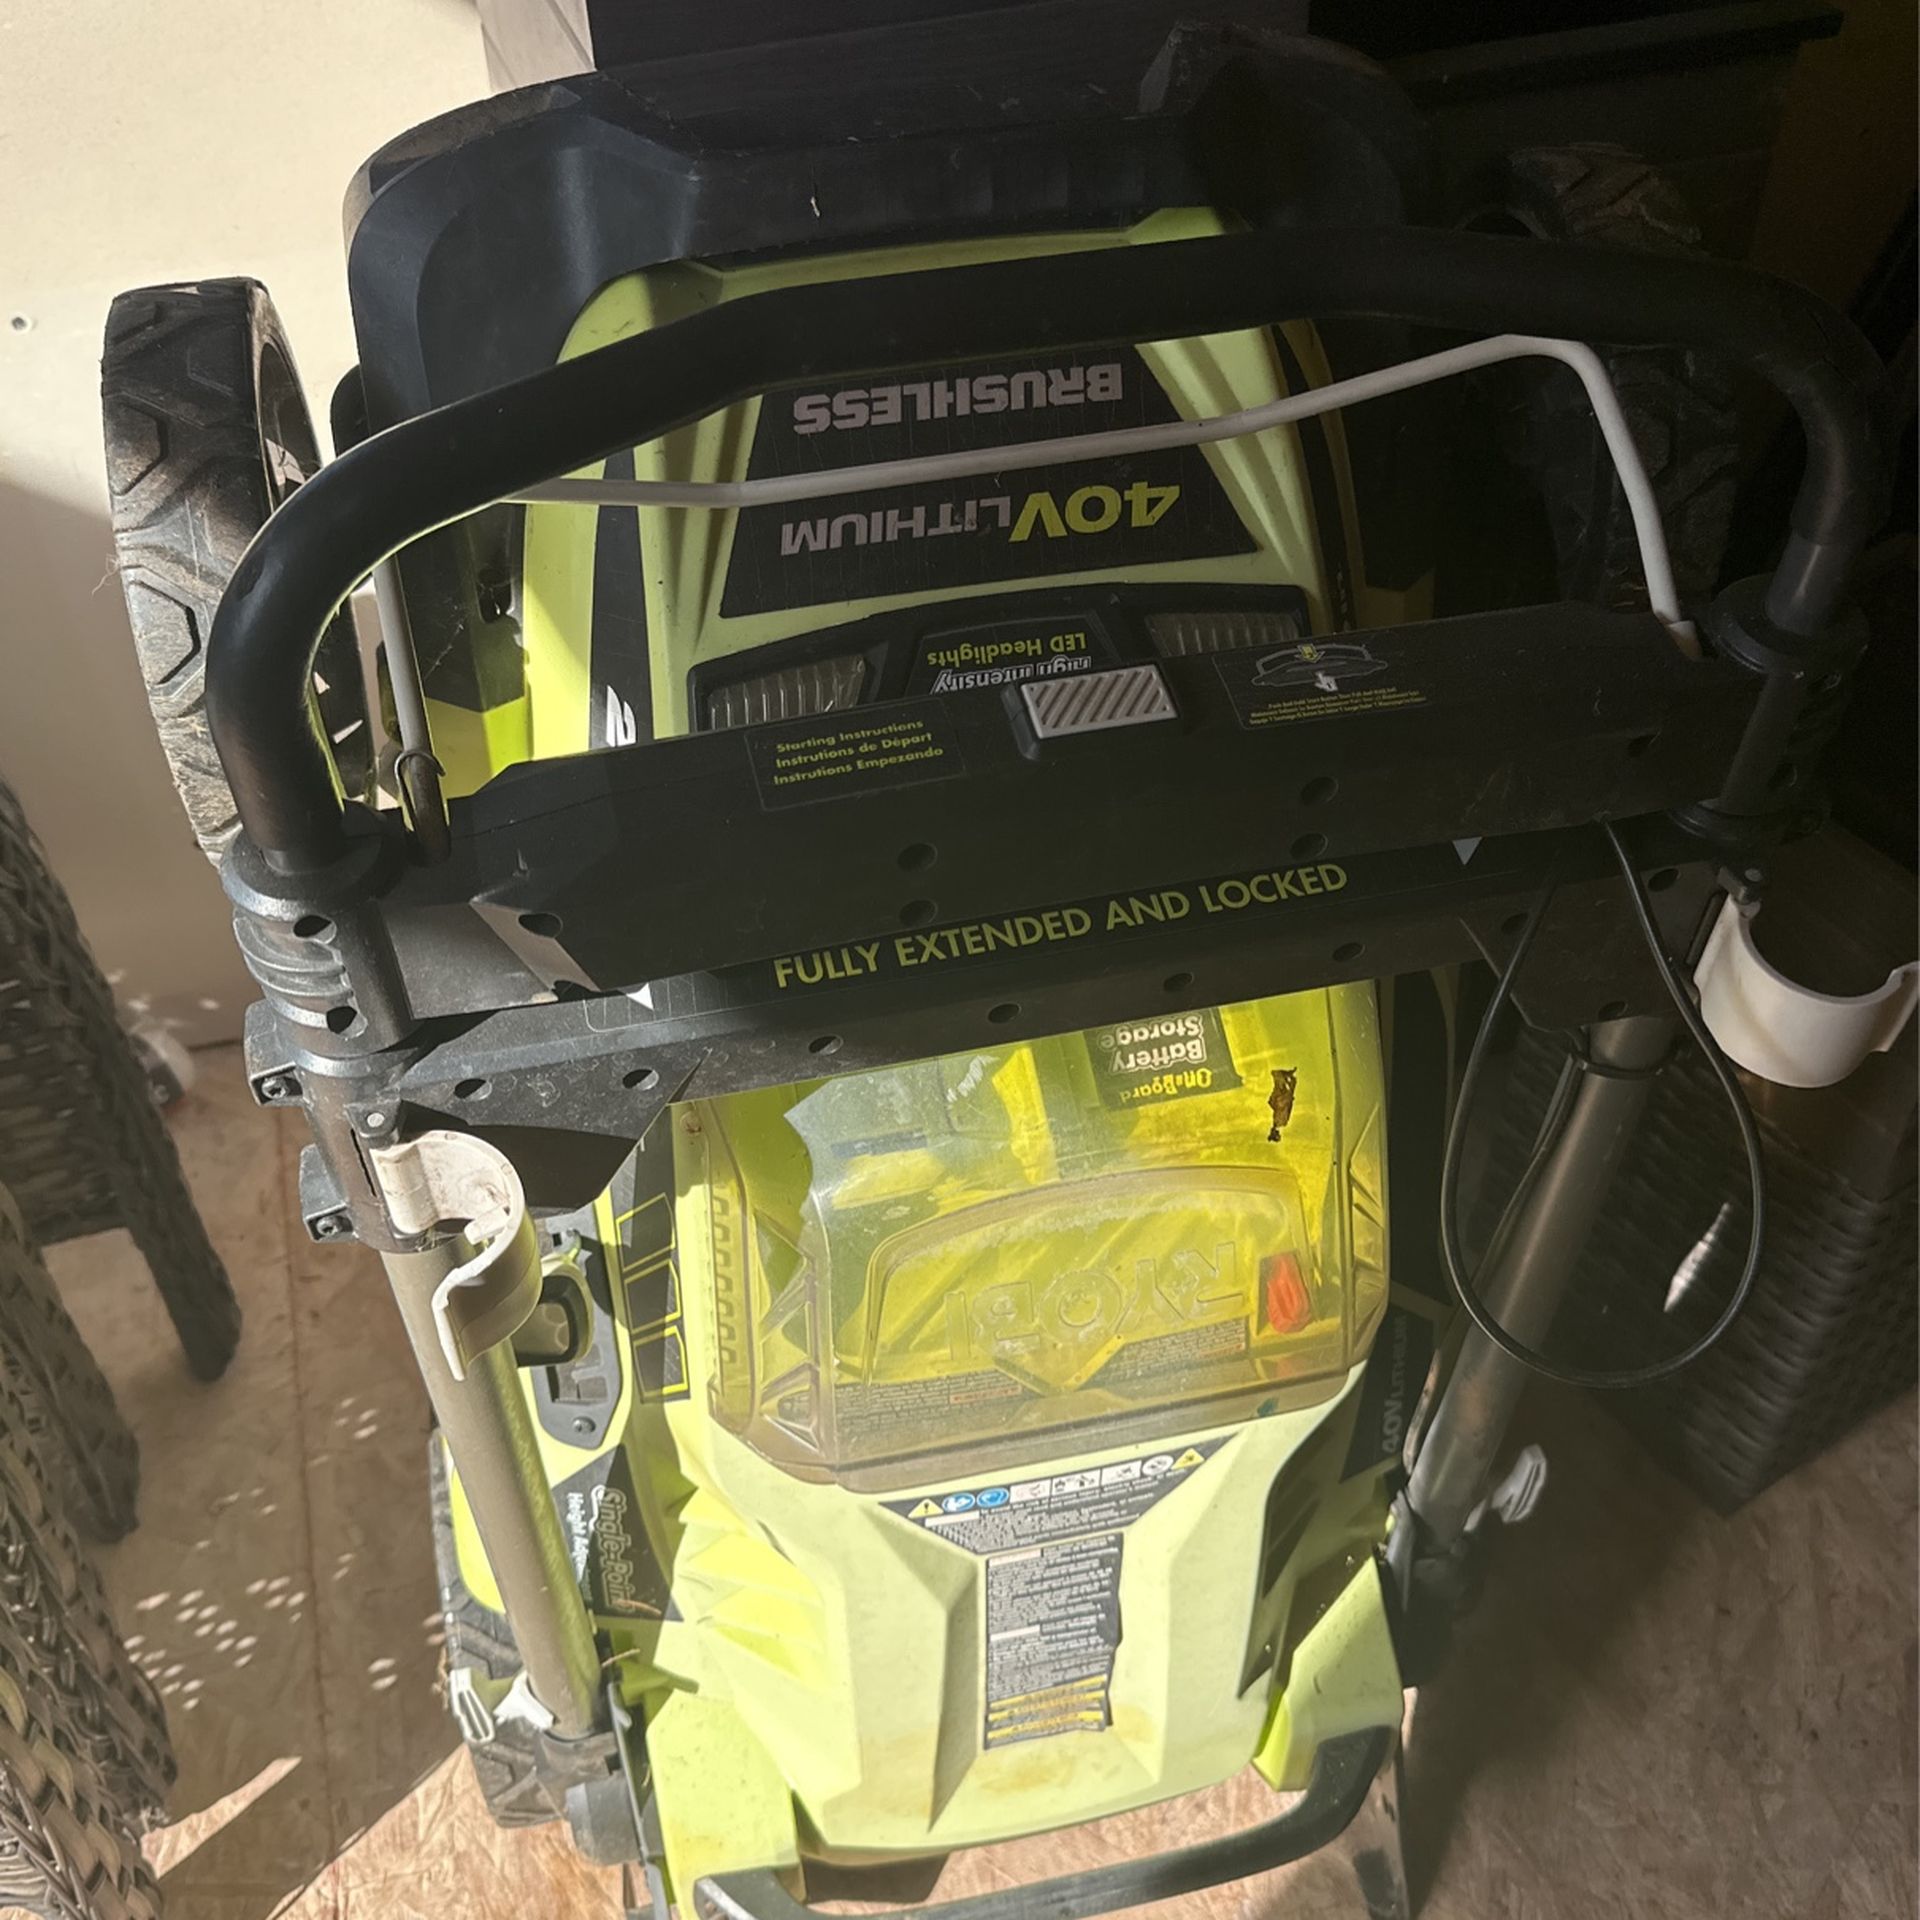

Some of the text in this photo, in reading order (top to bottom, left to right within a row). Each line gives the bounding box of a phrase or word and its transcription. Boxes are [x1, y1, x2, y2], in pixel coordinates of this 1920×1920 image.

[793, 363, 1122, 434] BRUSHLESS
[928, 632, 1086, 667] LED Headlights
[776, 720, 923, 753] Starting Instructions
[776, 732, 932, 769] Instrutions de Départ
[774, 747, 944, 785] Instrutions Empezando
[773, 863, 1347, 988] FULLY EXTENDED AND LOCKED
[1100, 1015, 1200, 1049] Storage
[1111, 1038, 1203, 1073] Battery
[945, 1240, 1245, 1361] RYOBI
[566, 1492, 587, 1534] Height
